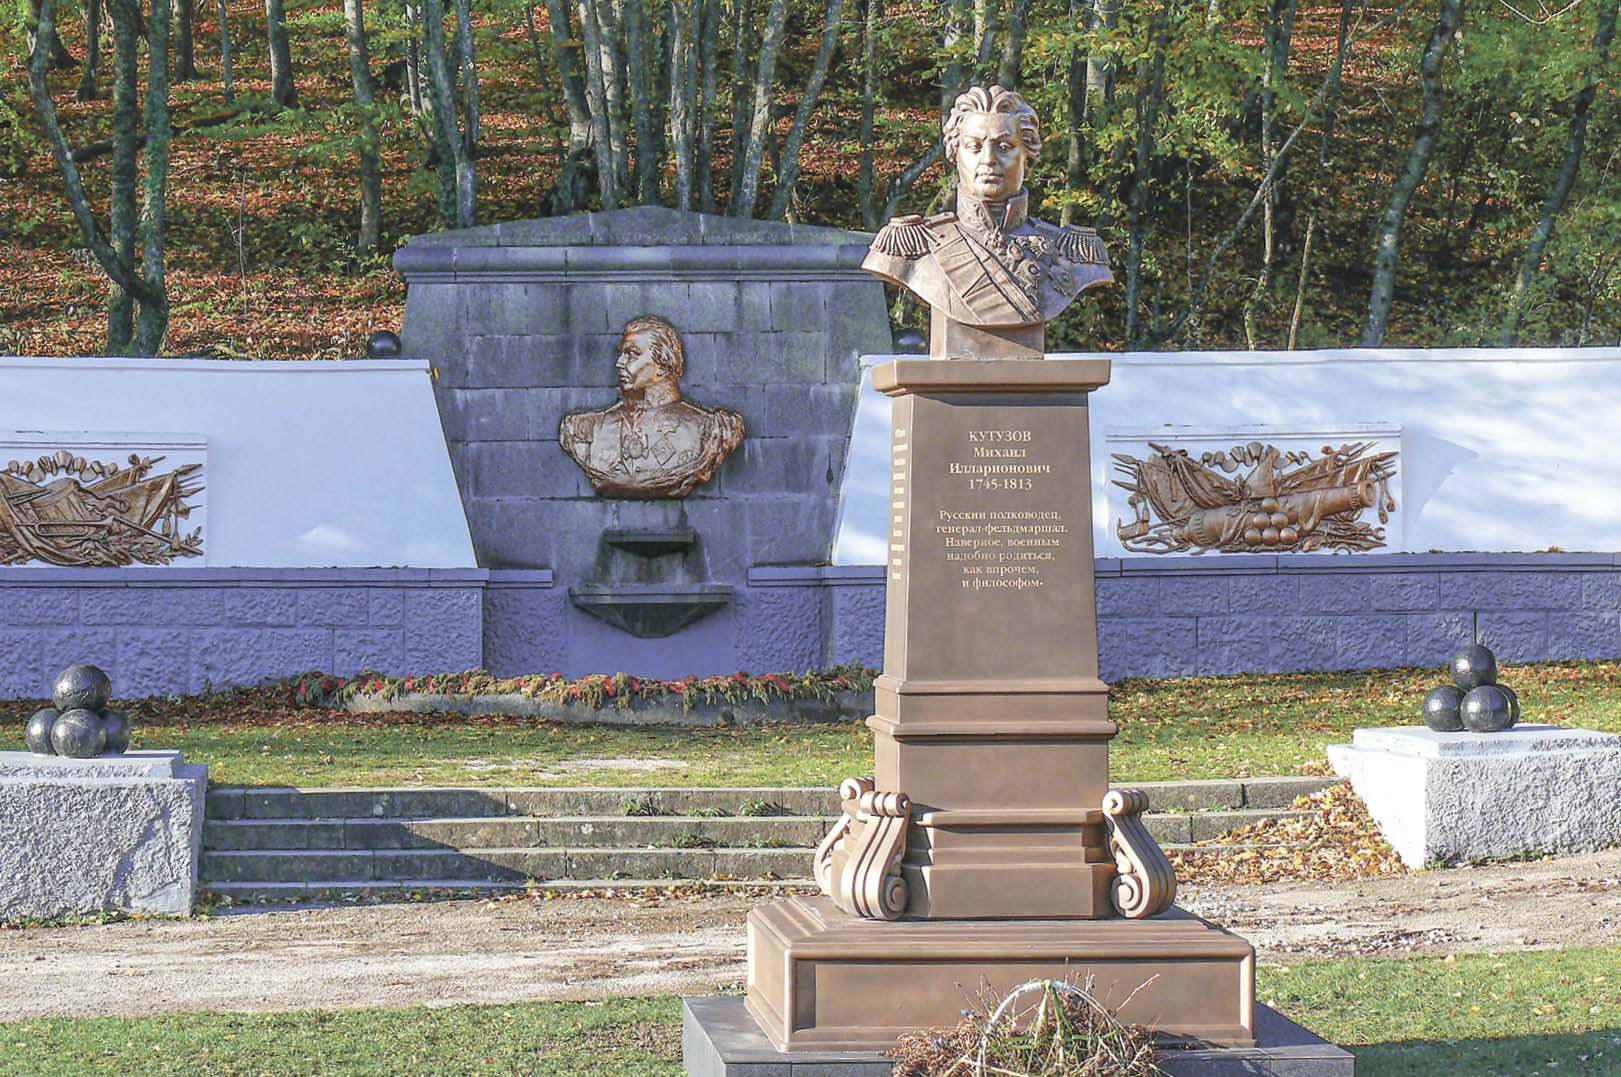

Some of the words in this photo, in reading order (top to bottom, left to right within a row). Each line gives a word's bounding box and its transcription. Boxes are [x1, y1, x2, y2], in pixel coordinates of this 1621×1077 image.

[969, 430, 1032, 442] КУТУЗОВ
[974, 447, 1027, 458] Михаил
[949, 463, 1051, 477] Илларионович
[969, 478, 1033, 491] 1745-1813
[939, 510, 987, 523] Русский
[1008, 539, 1060, 547] военным
[947, 551, 996, 562] надобно
[963, 566, 983, 574] как
[961, 579, 970, 588] и
